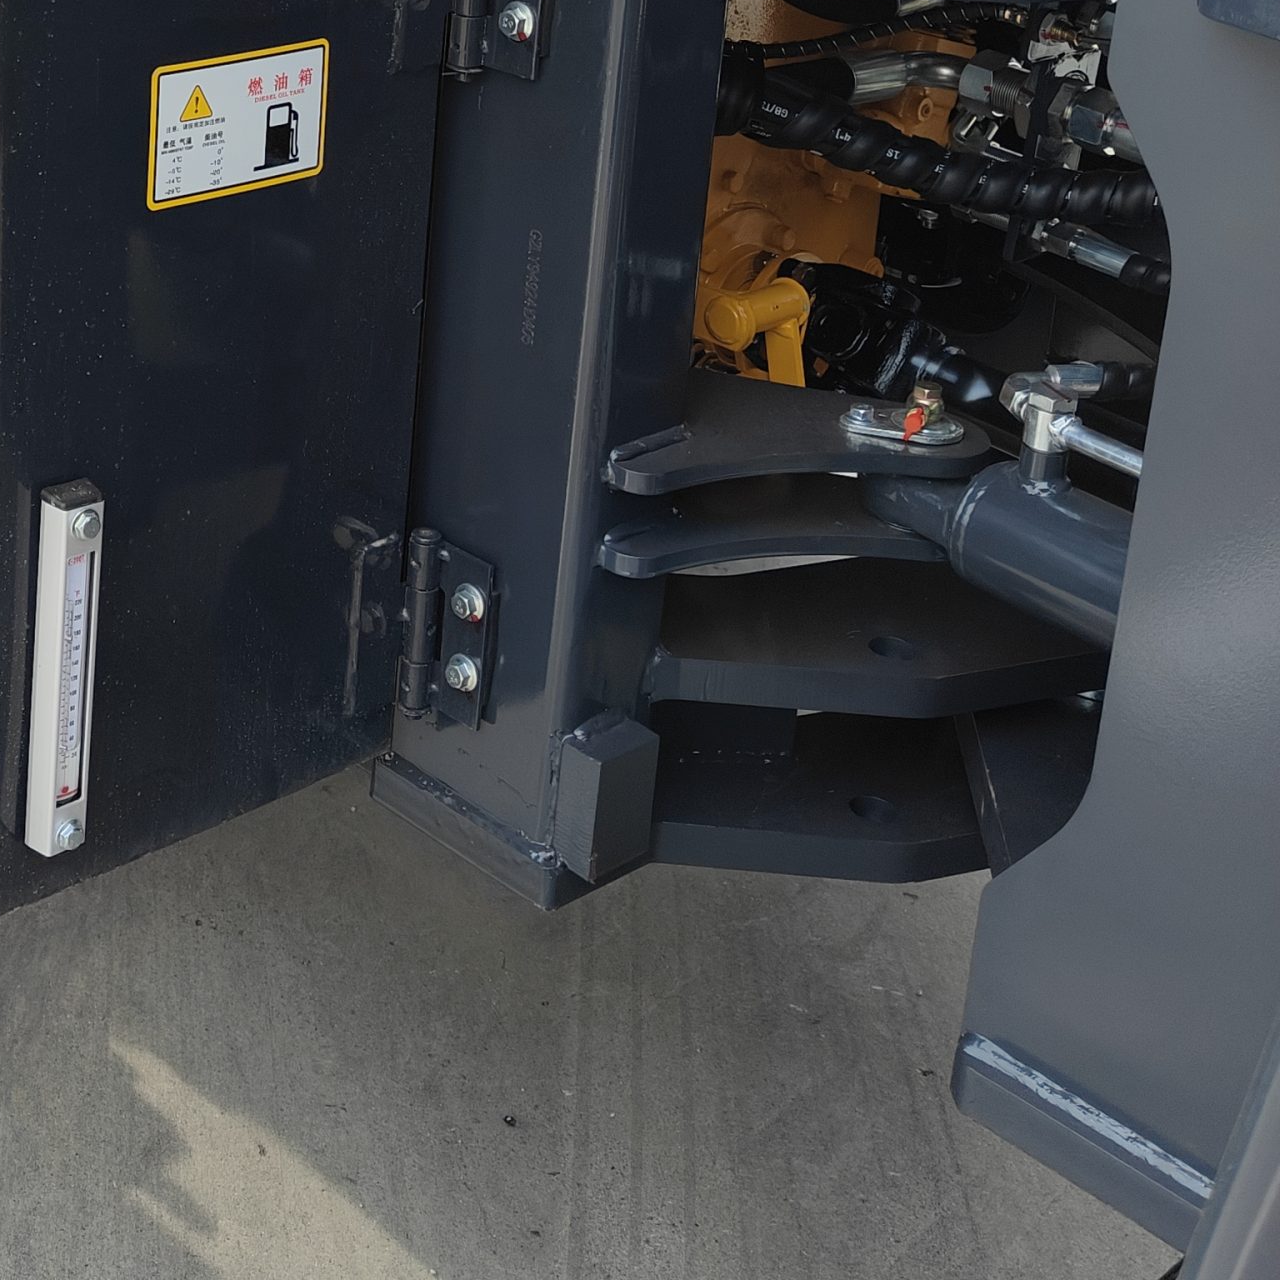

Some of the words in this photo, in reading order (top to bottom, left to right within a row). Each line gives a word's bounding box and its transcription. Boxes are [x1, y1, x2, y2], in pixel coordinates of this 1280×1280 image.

[248, 67, 313, 96] 燃油箱
[255, 94, 277, 103] DIESEL
[278, 91, 289, 99] OIL
